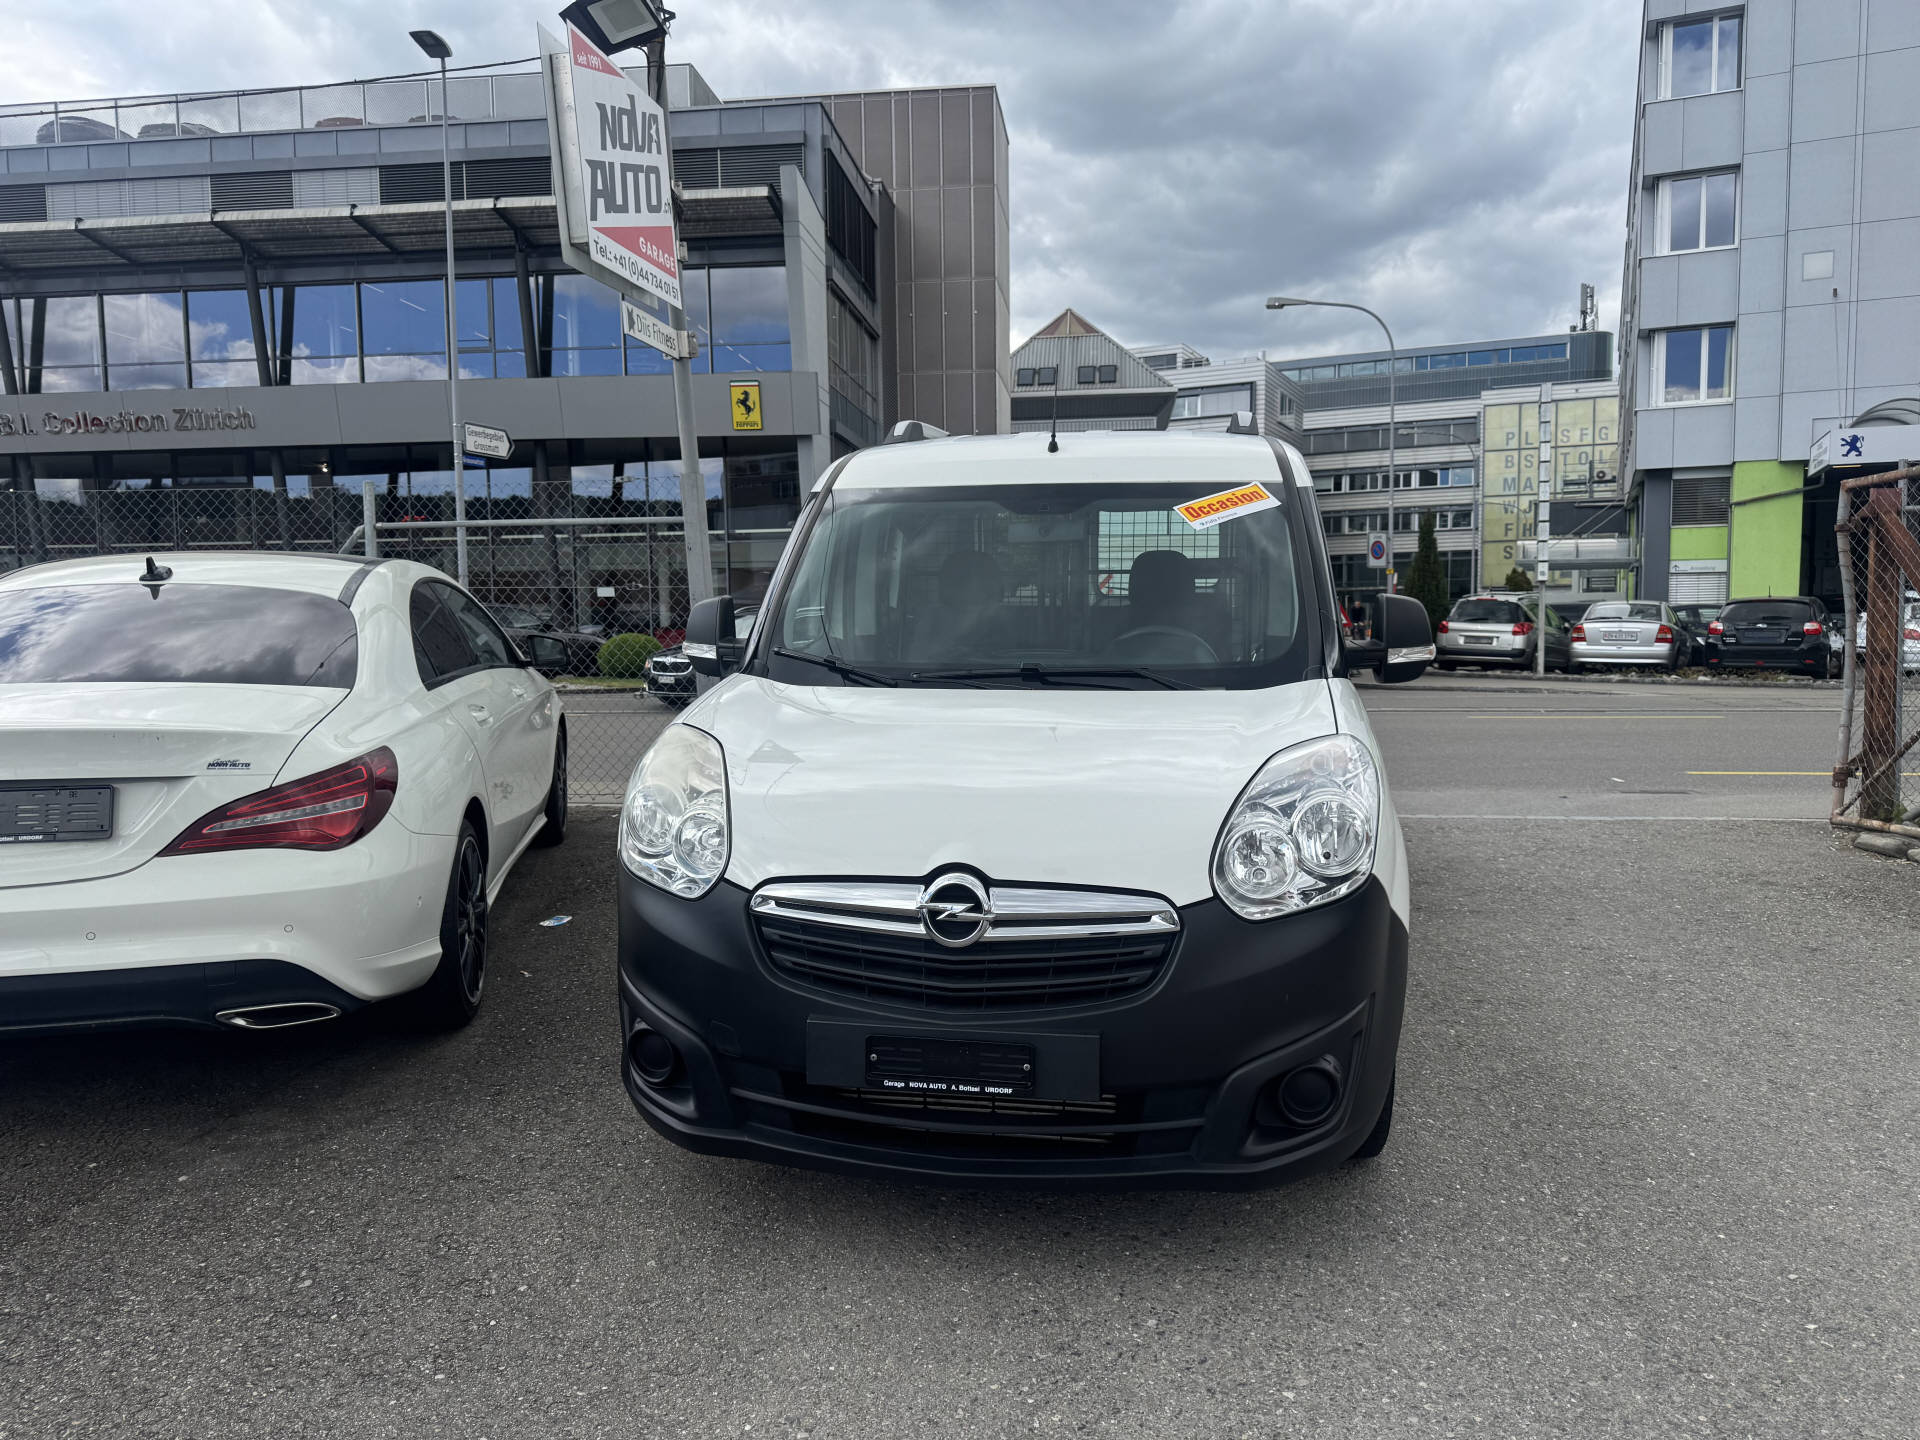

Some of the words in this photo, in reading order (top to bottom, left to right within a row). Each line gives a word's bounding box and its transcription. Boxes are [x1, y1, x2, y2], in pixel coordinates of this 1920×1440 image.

[576, 51, 587, 65] seit
[588, 53, 602, 70] 1991
[595, 94, 662, 155] NOVA
[584, 159, 662, 222] AUTO
[594, 238, 612, 262] Tel.:
[613, 253, 627, 271] +41
[650, 272, 664, 291] 734
[664, 281, 672, 296] 01
[639, 236, 676, 272] GARAGE
[652, 322, 676, 351] Fitness
[43, 409, 168, 435] Collection
[172, 405, 257, 432] Zürich
[1184, 489, 1265, 519] Occasion
[883, 1079, 905, 1088] Garage
[909, 1081, 928, 1089] NOVA
[929, 1082, 947, 1090] AUTO
[984, 1087, 1013, 1095] URDORF
